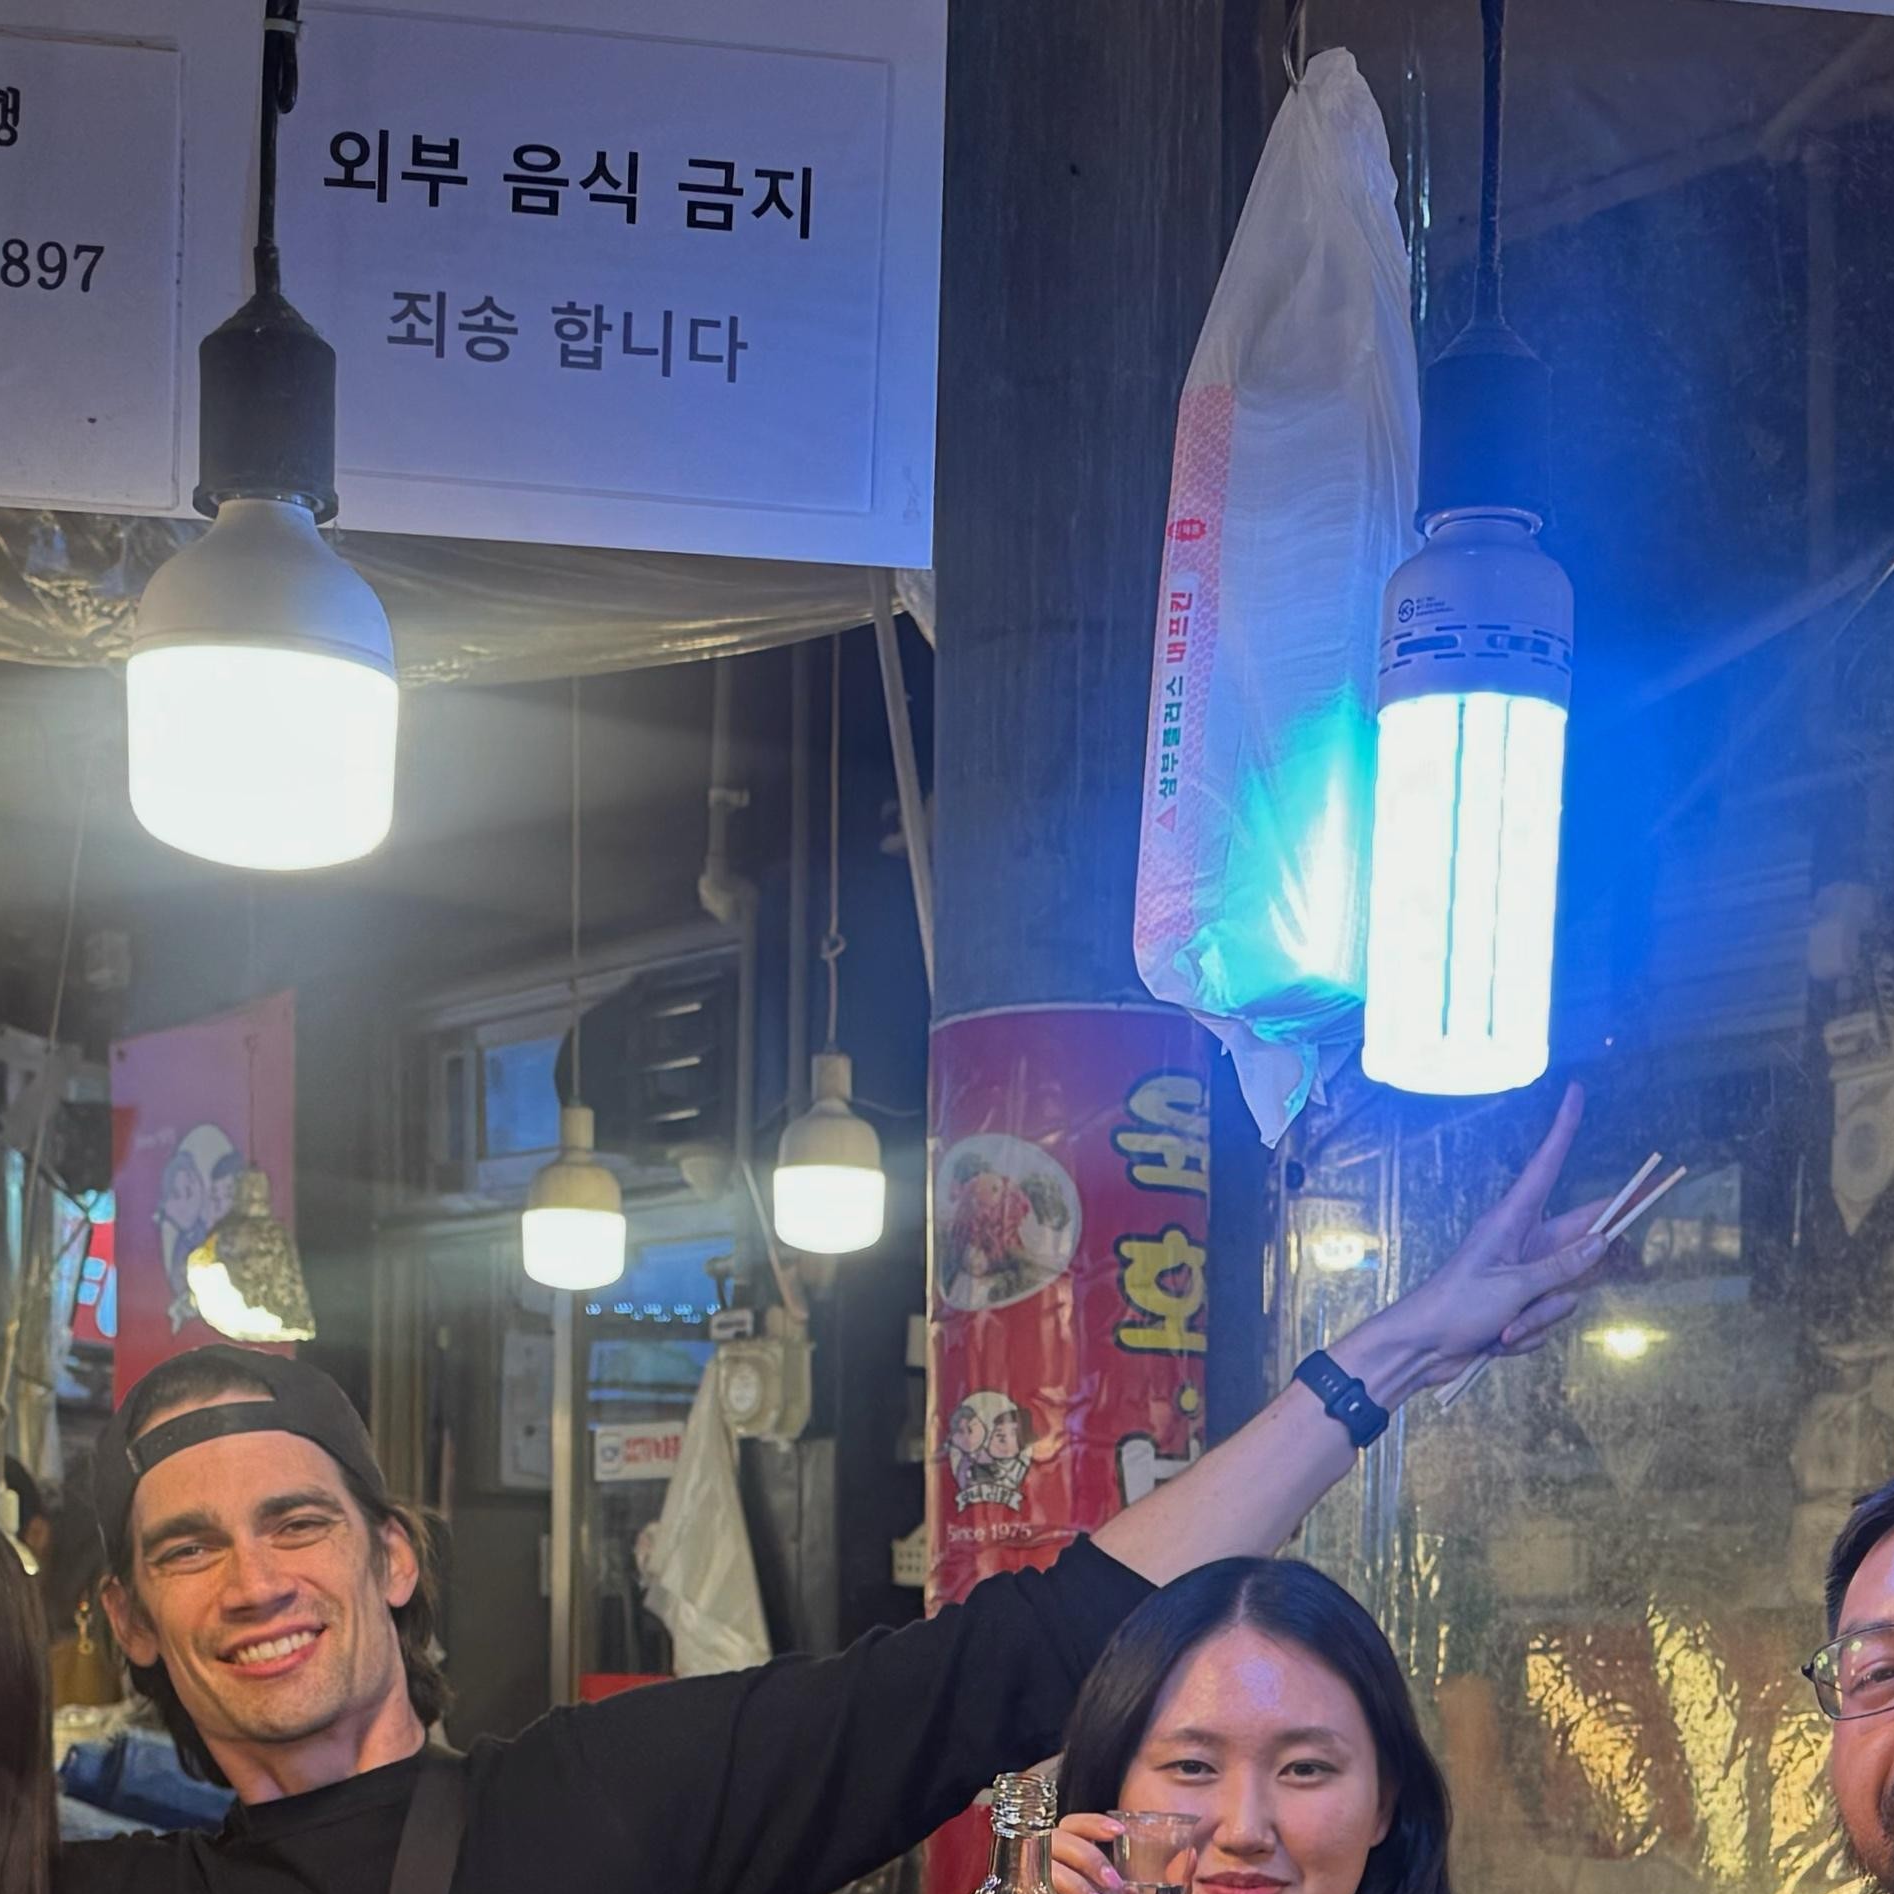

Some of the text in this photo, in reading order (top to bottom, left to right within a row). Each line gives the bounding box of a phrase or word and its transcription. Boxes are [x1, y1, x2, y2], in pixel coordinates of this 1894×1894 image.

[324, 129, 813, 239] 외부 음식 금지
[387, 289, 749, 383] 죄송 합니다
[1165, 591, 1194, 664] 내프킨
